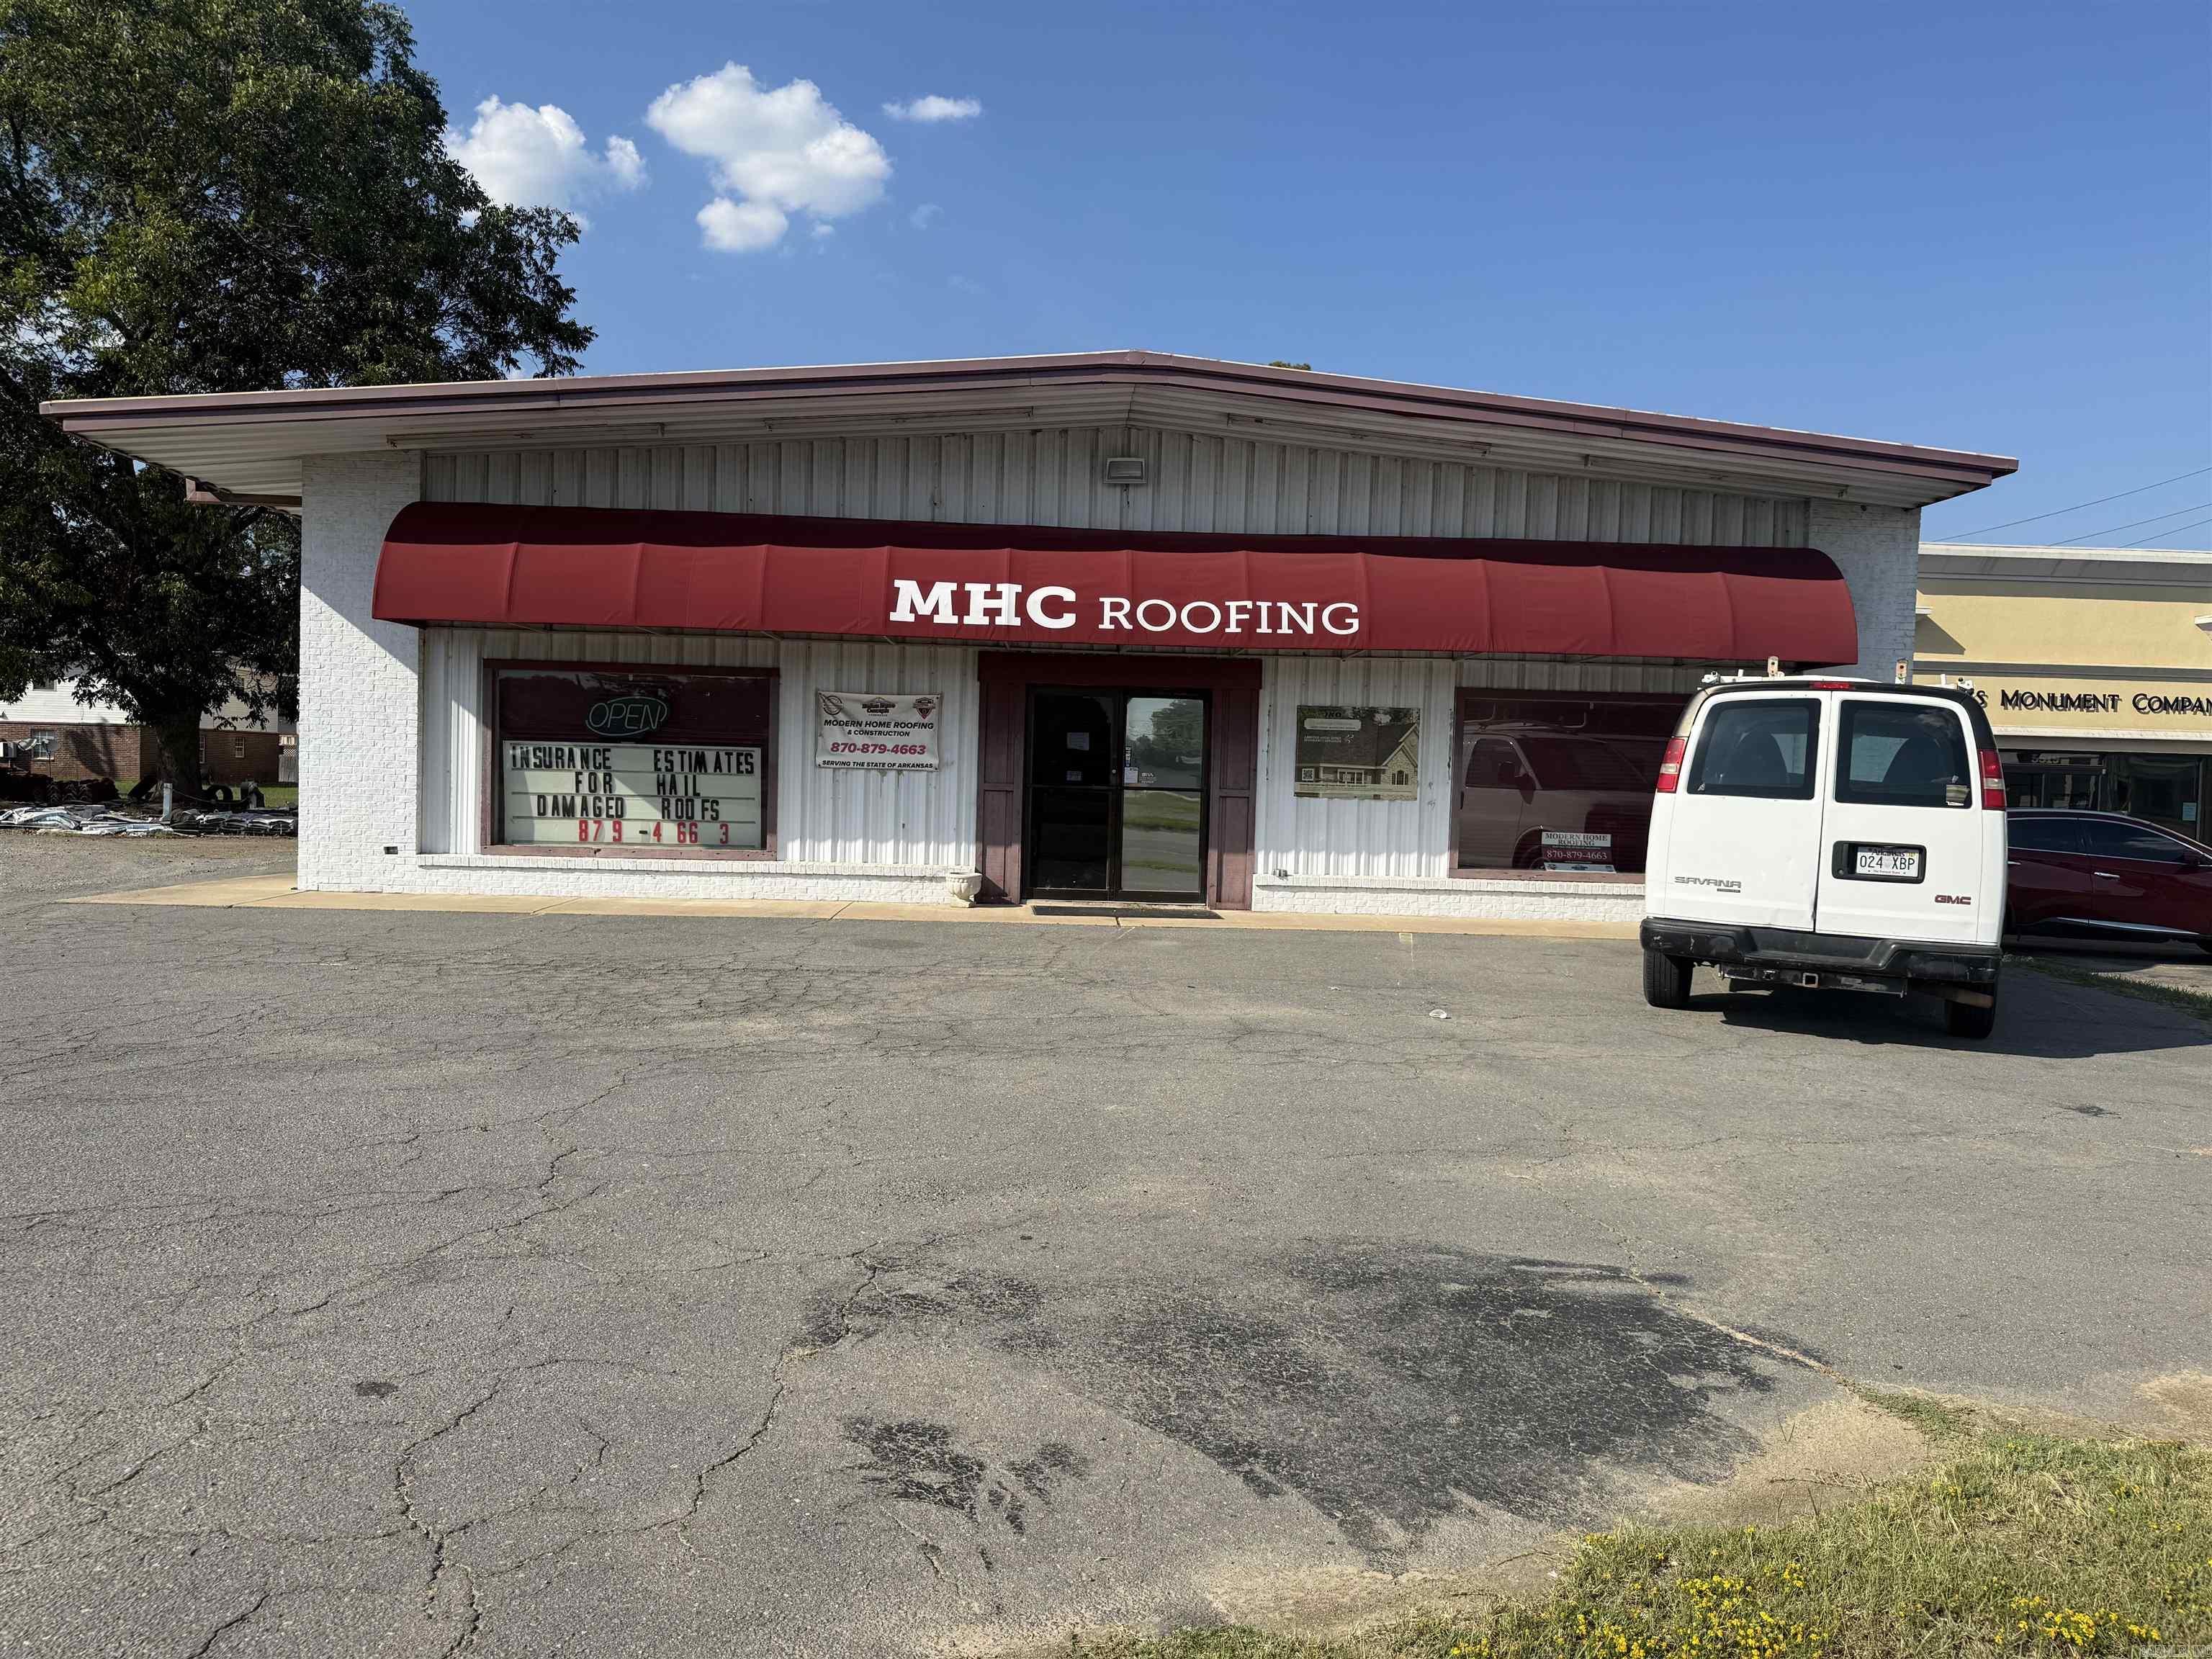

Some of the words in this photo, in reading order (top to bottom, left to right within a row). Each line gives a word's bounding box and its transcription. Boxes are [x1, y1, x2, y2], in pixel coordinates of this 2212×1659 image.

[889, 579, 1076, 629] MHC
[1099, 597, 1359, 635] ROOFING
[2000, 689, 2121, 709] MONUMENT
[589, 703, 662, 730] OPEN
[830, 742, 926, 755] 870-879-4663
[512, 746, 611, 770] INSURANCE
[653, 750, 755, 774] ESTIMATES
[575, 772, 613, 793] FOR
[657, 774, 701, 796] HAIL
[536, 795, 624, 818] DAMAGED
[662, 798, 720, 821] ROOFS
[1547, 850, 1607, 860] 870-879-4663
[1871, 847, 1905, 857] Arkansas
[1860, 855, 1883, 868] 024
[1892, 857, 1915, 870] XBP
[1674, 876, 1741, 889] SAVANA
[1935, 894, 1972, 905] GMC
